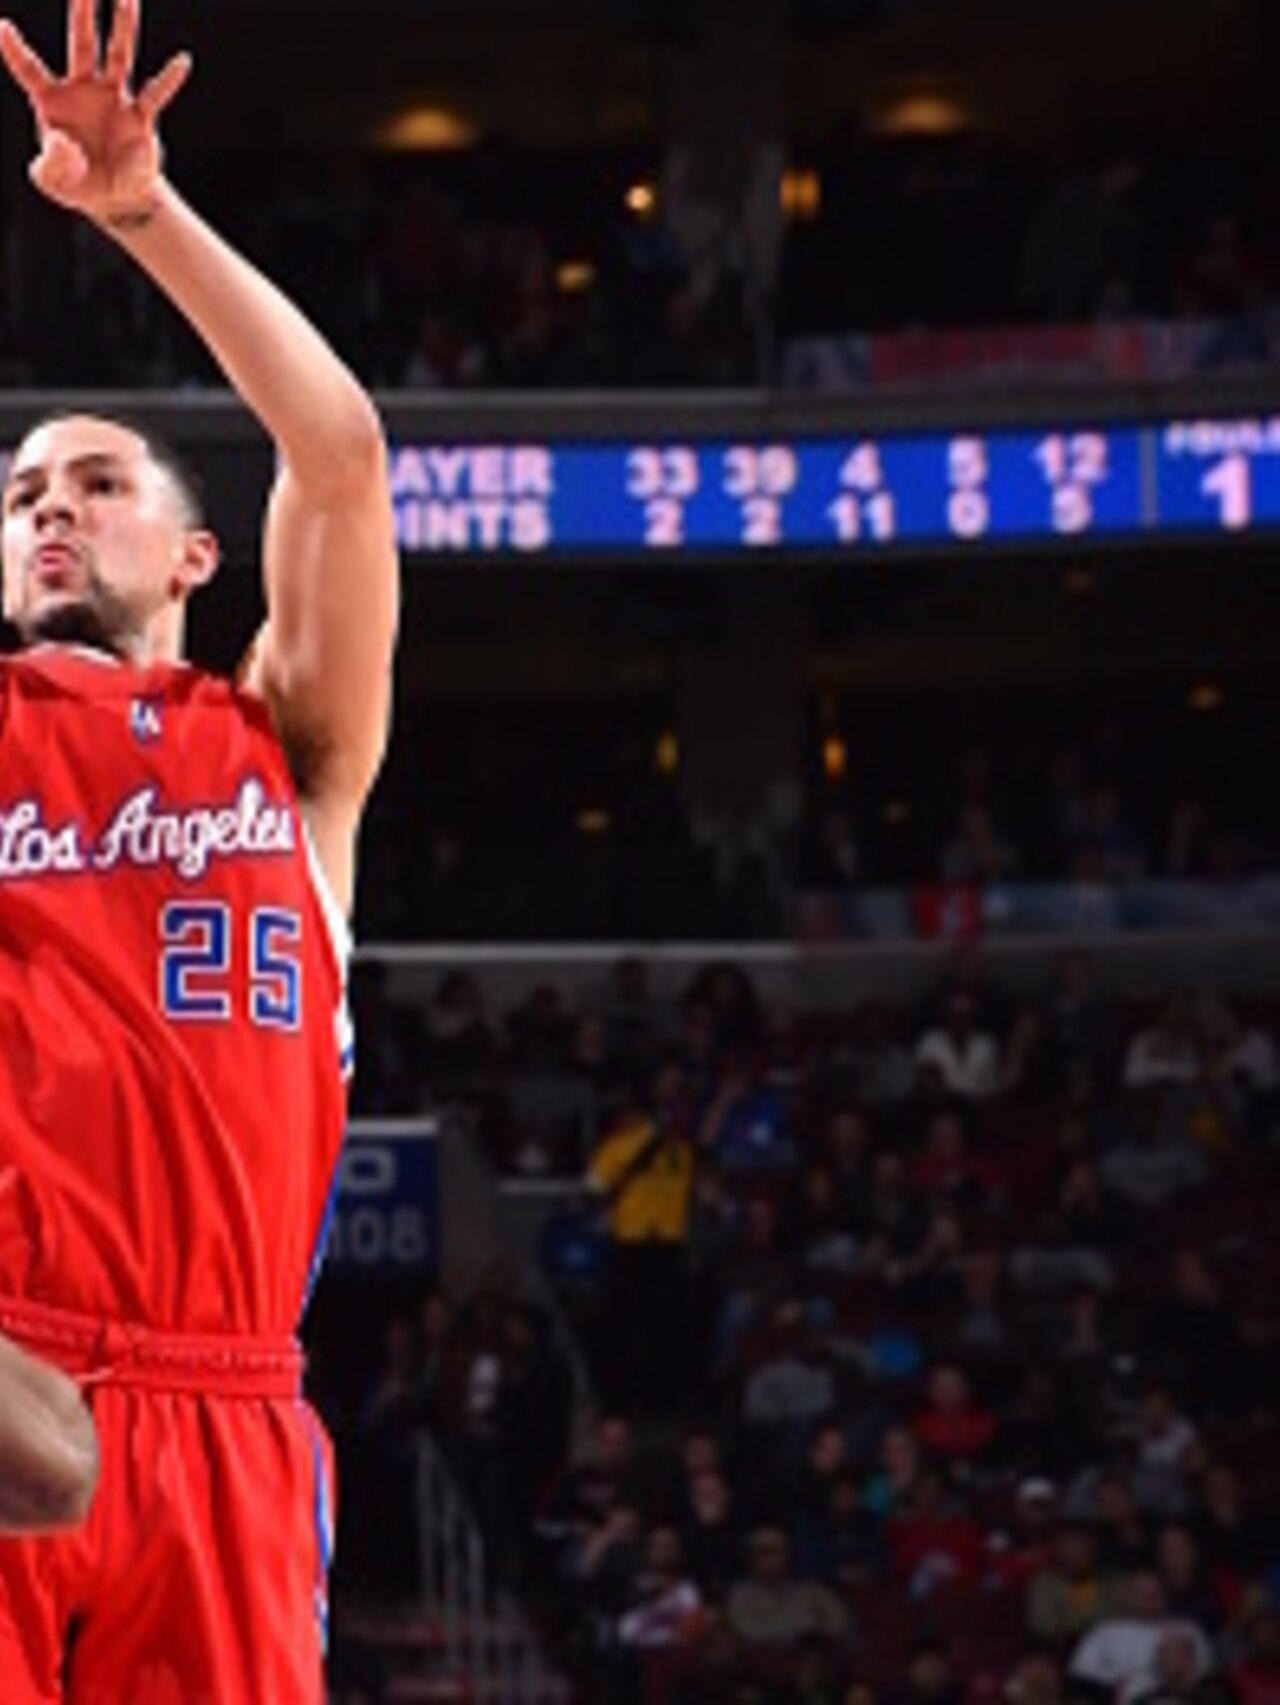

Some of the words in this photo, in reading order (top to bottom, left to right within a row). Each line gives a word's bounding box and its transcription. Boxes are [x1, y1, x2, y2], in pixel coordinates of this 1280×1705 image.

[626, 447, 700, 499] 33
[840, 441, 881, 491] 4
[1032, 432, 1108, 482] 12
[1201, 455, 1251, 530] 1
[643, 500, 684, 548] 2
[741, 500, 782, 547] 2
[828, 492, 894, 544] 11
[948, 487, 989, 538] 0
[93, 774, 295, 879] Angeles
[158, 899, 304, 1032] 25
